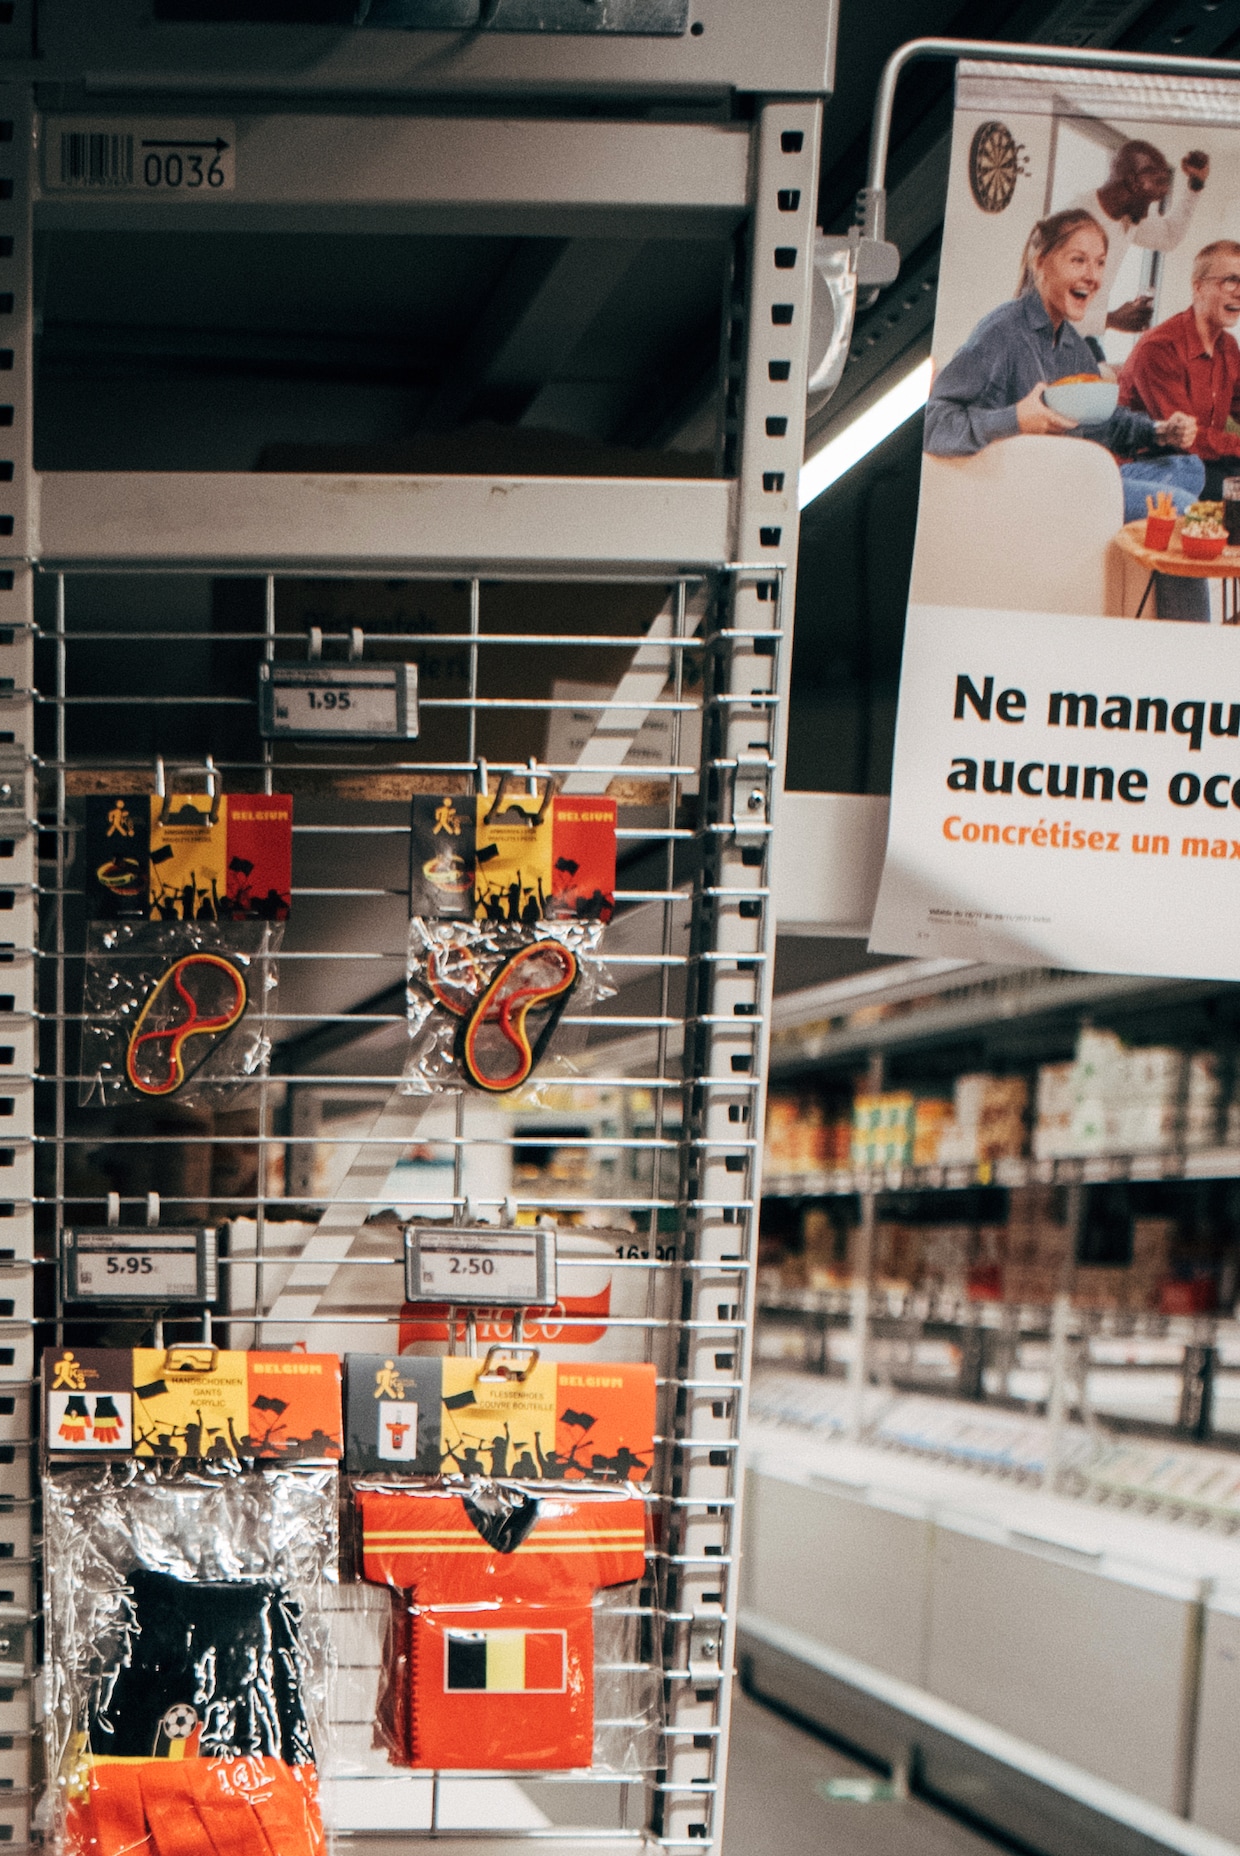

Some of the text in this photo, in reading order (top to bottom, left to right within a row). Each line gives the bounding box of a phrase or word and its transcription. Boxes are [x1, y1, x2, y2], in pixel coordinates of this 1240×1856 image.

[144, 153, 226, 188] 0036
[953, 673, 1240, 752] Ne manqu
[946, 755, 1149, 804] aucune
[231, 810, 290, 821] BELGIUM
[557, 811, 614, 823] BELGIUM
[942, 814, 1121, 852] Concrétisez
[1131, 832, 1170, 856] un
[252, 1362, 323, 1377] BELGIUM
[170, 1376, 243, 1387] HANDSCHOENEN
[558, 1375, 624, 1389] BELGIUM
[193, 1388, 223, 1397] GANTS
[489, 1390, 545, 1400] FLESSENHOES
[189, 1399, 227, 1408] ACRYLIC
[479, 1401, 555, 1412] COUVRE BOUTEILLE
